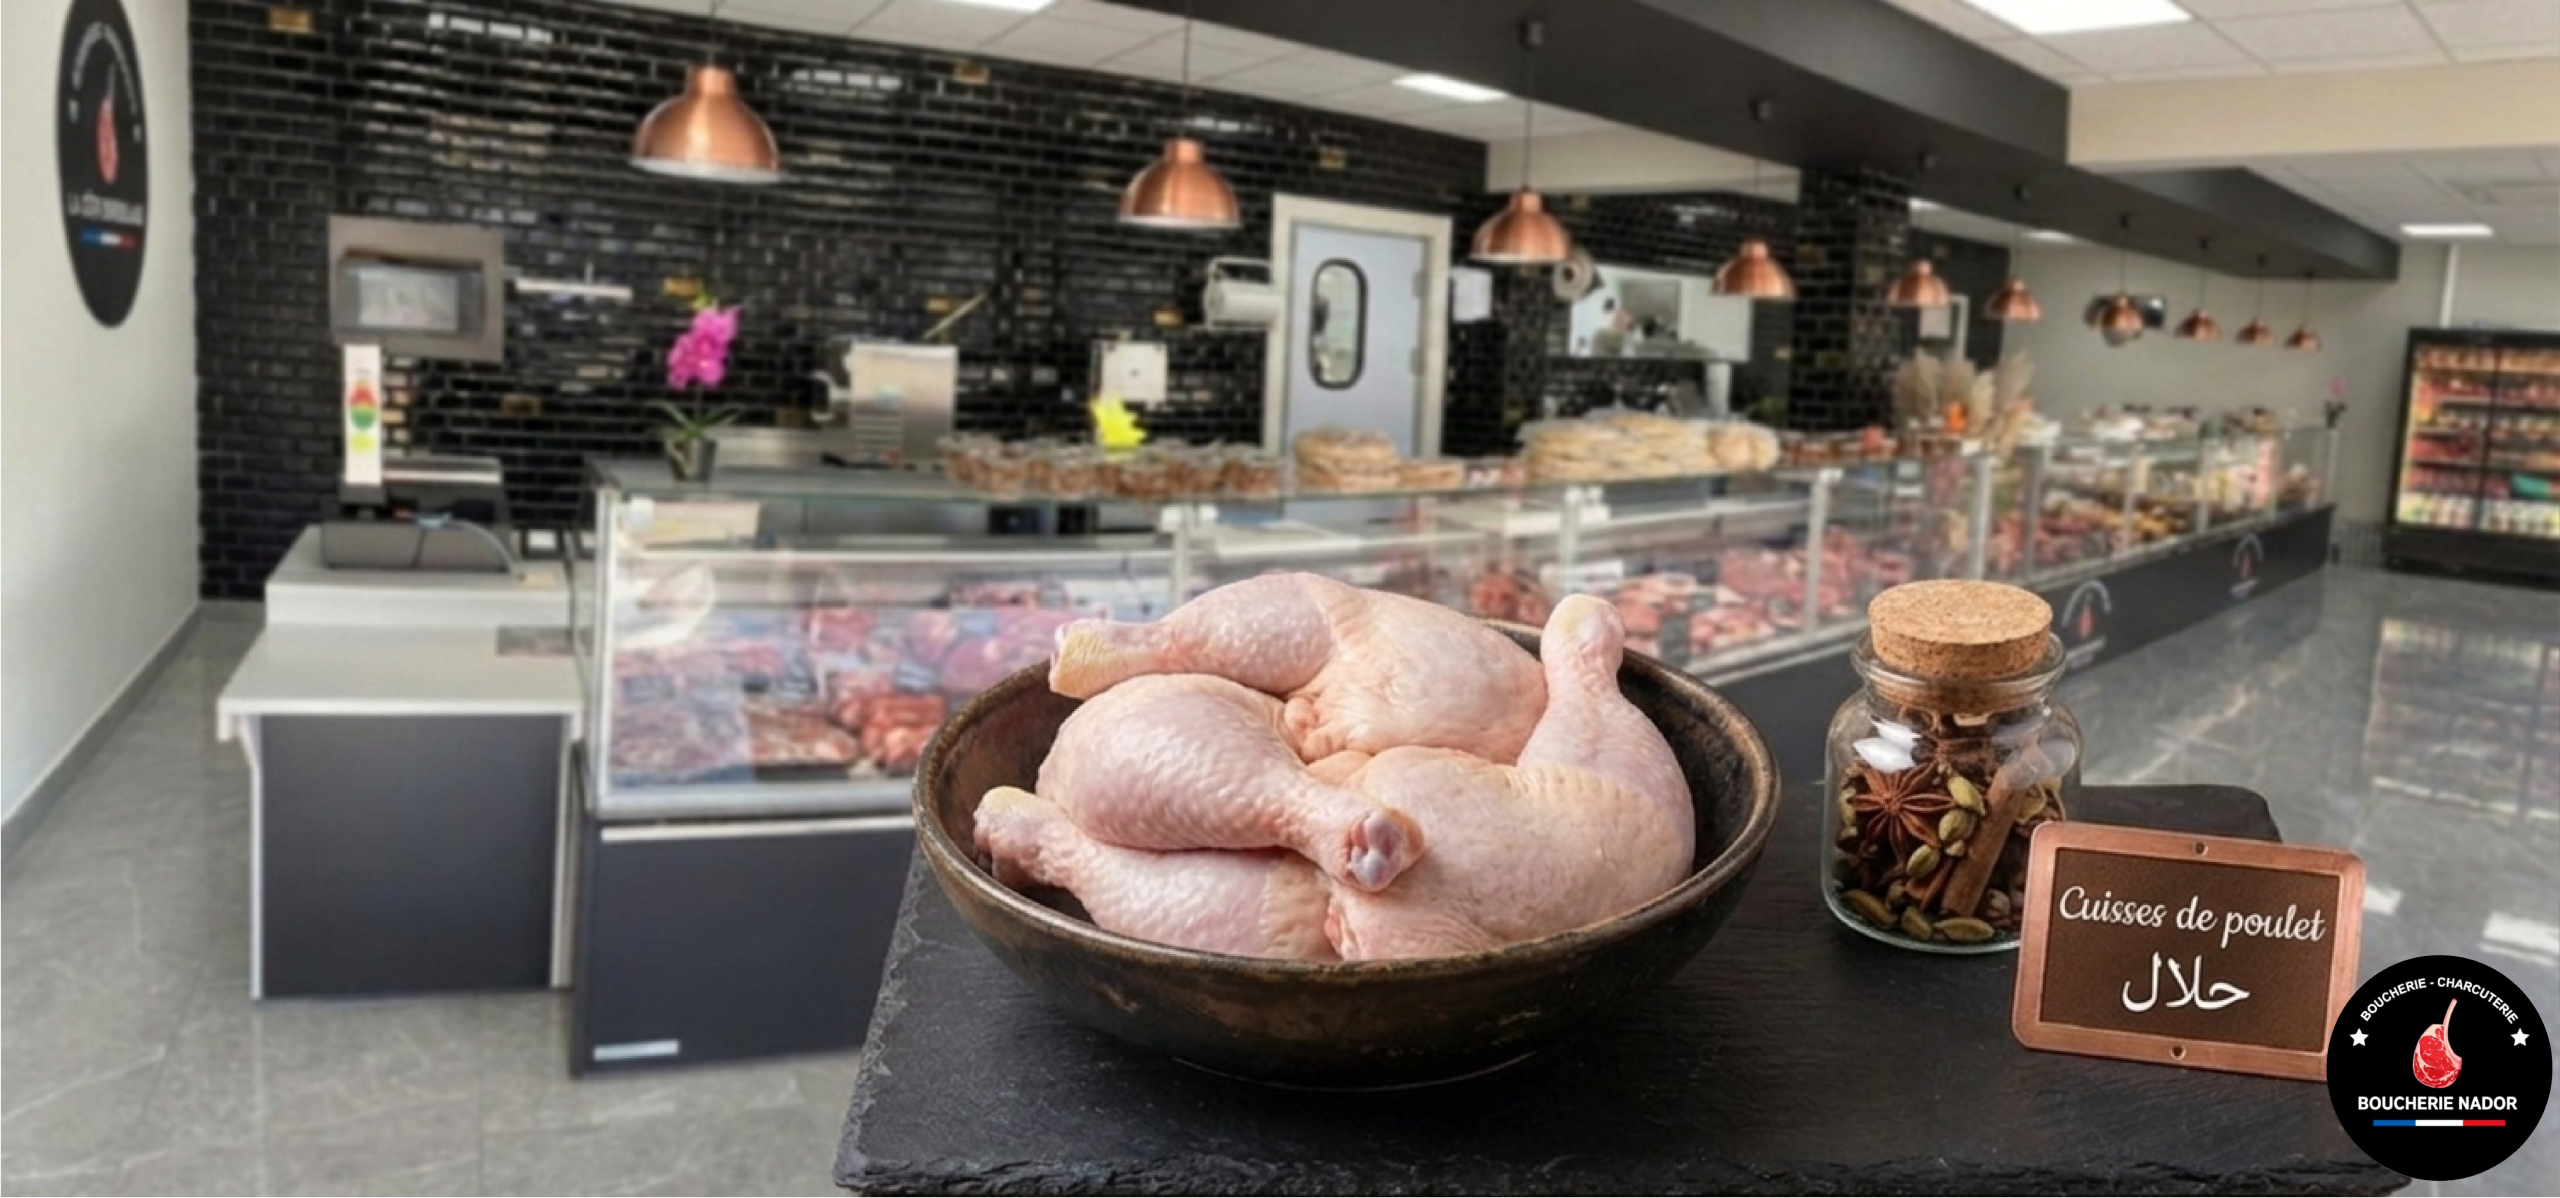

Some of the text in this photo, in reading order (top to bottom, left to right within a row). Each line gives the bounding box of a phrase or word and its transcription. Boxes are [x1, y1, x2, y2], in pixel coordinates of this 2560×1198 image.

[2060, 886, 2326, 949] Cuisses de poulet
[2122, 951, 2251, 1012] حلال
